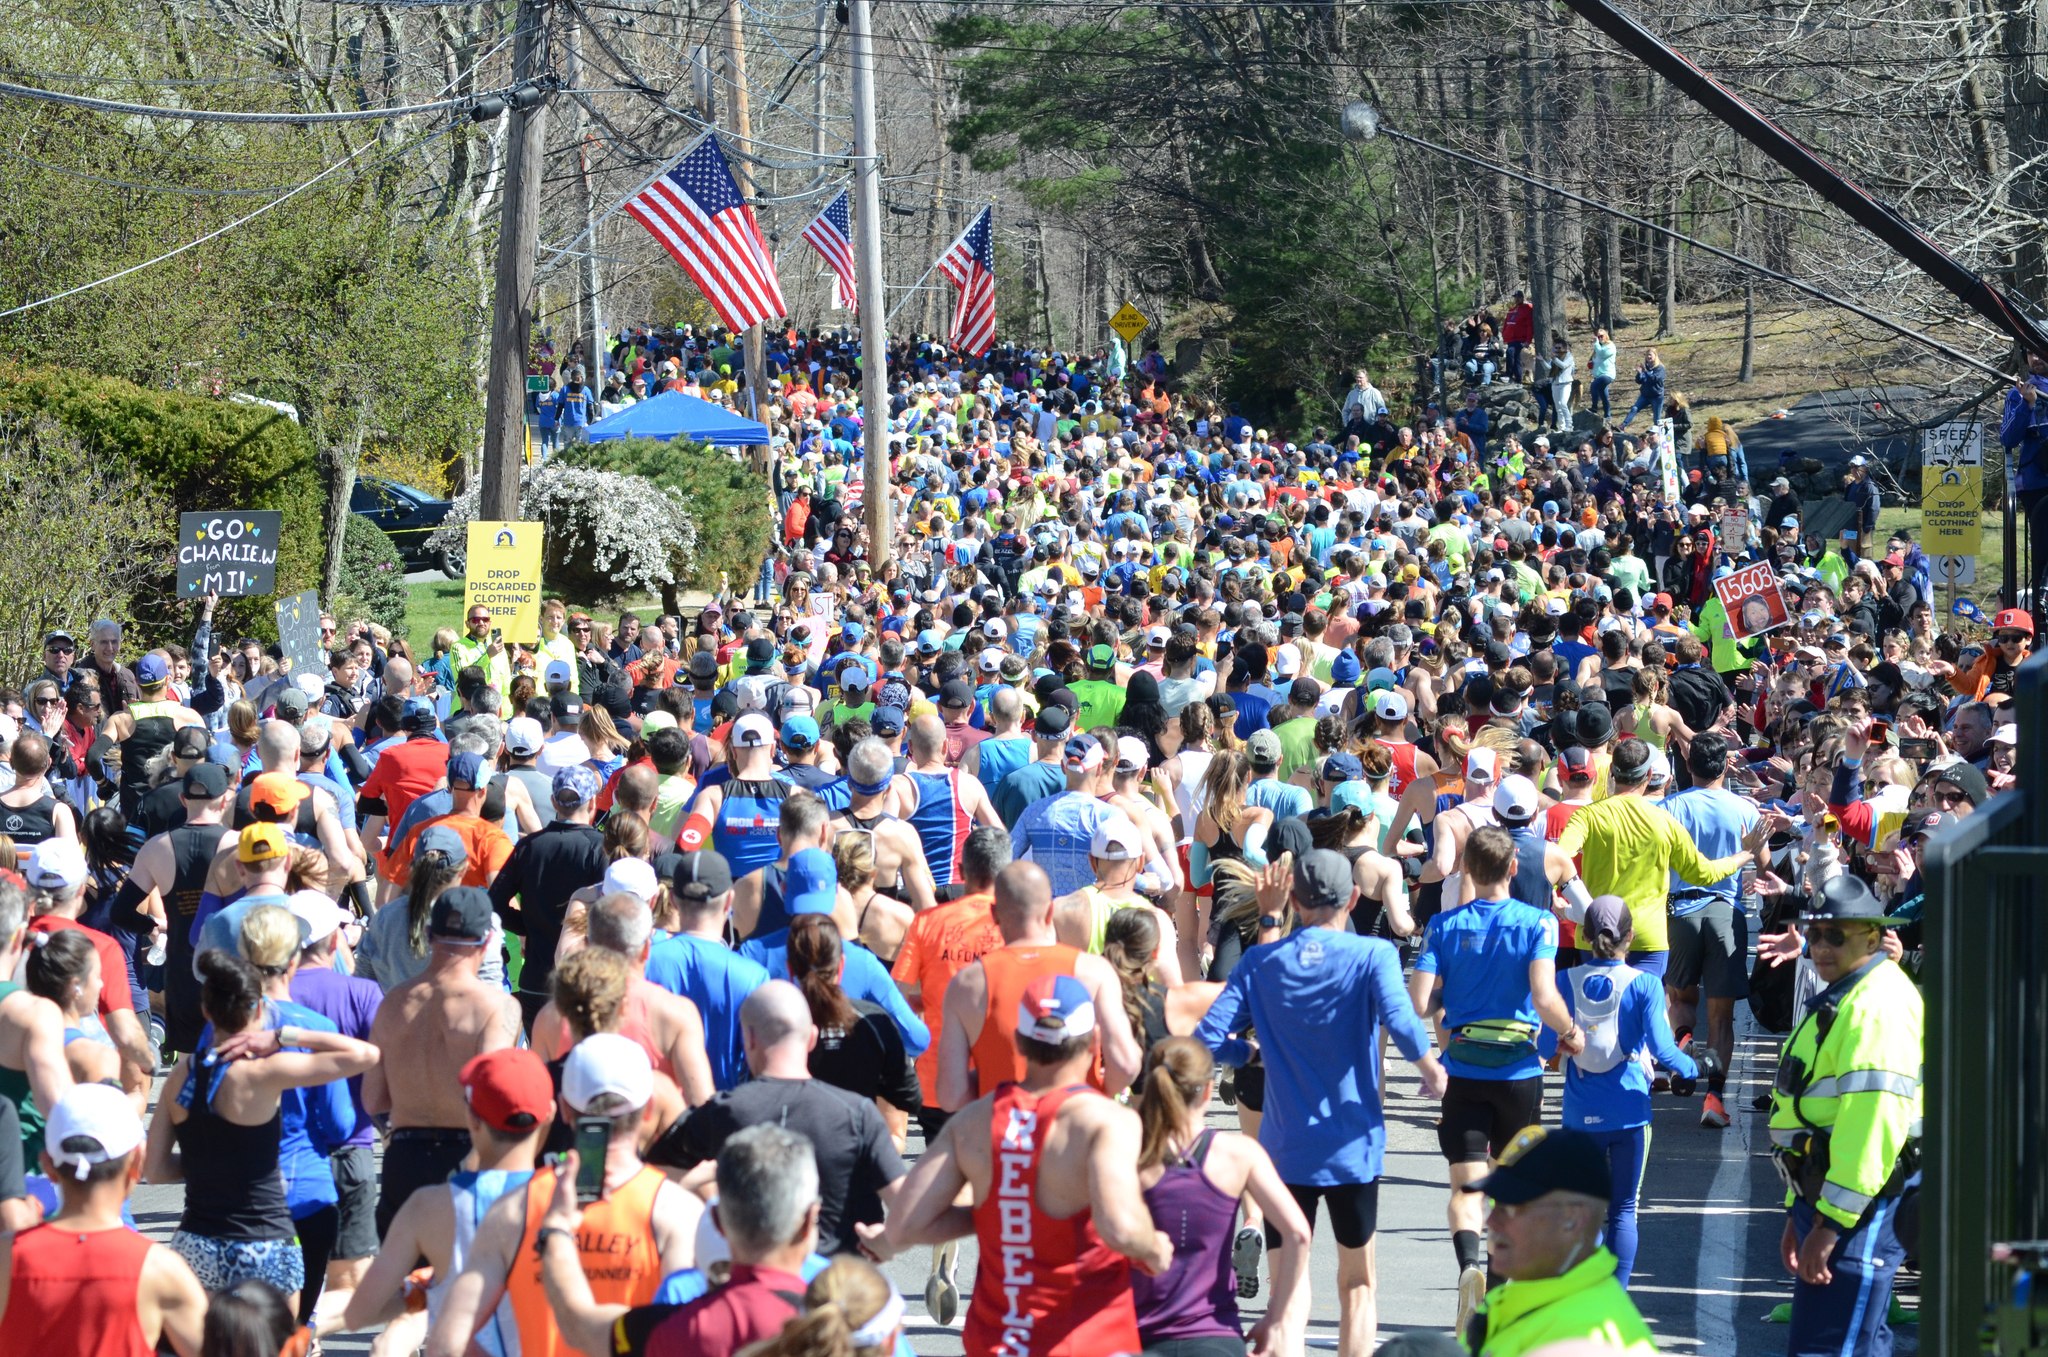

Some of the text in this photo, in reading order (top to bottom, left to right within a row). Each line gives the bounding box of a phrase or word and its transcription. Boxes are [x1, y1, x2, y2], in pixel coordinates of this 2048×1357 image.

[1928, 429, 1978, 441] SPEED
[1934, 444, 1972, 456] LIMIT
[1938, 501, 1965, 509] DROP
[1925, 510, 1979, 518] DISCARDED
[1928, 518, 1975, 527] CLOTHING
[207, 518, 244, 541] GO
[1938, 528, 1964, 536] HERE
[179, 542, 277, 565] CHARLIE.W
[487, 569, 520, 579] DROP
[203, 570, 246, 595] MI!
[469, 581, 537, 592] DISCARDED
[1719, 565, 1773, 604] 15603
[473, 593, 531, 604] CLOTHING
[487, 606, 517, 616] HERE
[997, 1106, 1038, 1357] REBELS
